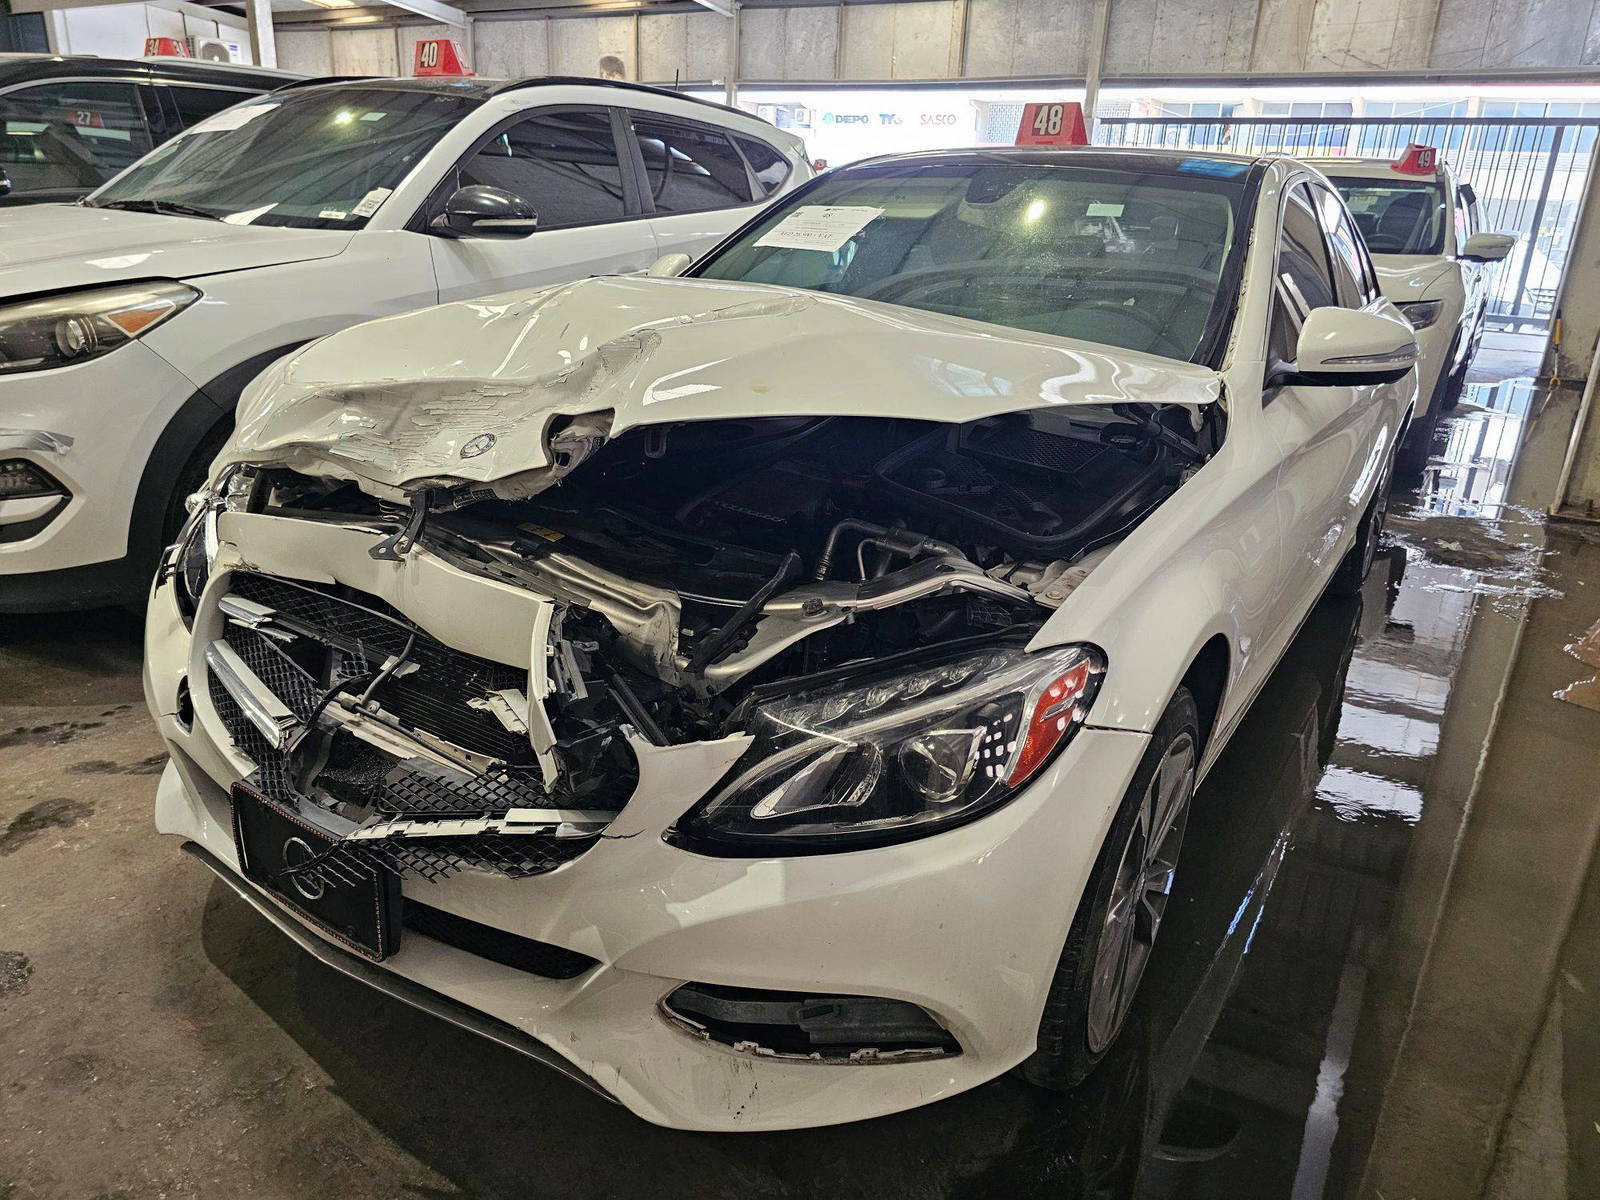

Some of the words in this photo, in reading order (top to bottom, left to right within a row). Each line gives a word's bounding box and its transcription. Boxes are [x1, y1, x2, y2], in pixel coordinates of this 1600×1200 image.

[421, 41, 438, 67] 40
[76, 111, 91, 126] 27
[834, 114, 870, 125] DEPO
[919, 113, 957, 126] SASCO
[1033, 104, 1063, 135] 48
[1417, 150, 1431, 167] 49
